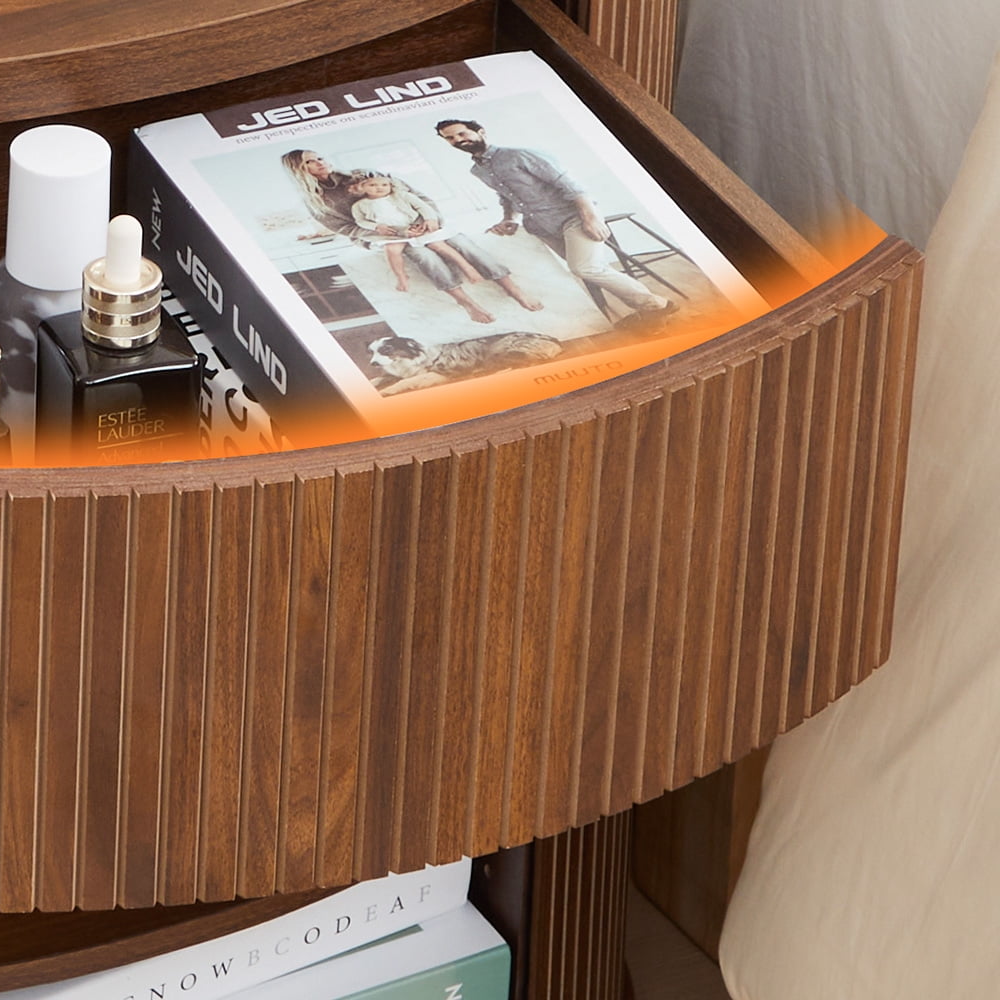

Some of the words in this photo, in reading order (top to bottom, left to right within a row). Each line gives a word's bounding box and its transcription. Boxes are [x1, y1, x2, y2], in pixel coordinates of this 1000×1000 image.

[236, 133, 261, 145] new
[264, 120, 337, 141] perspectives
[340, 116, 357, 124] on
[359, 100, 436, 119] scandinavian
[439, 91, 479, 107] design
[237, 100, 331, 131] JED
[343, 76, 453, 109] LIND
[151, 187, 163, 251] NEW
[176, 245, 225, 315] JED
[232, 304, 288, 396] LIND
[97, 419, 166, 443] LAUDER
